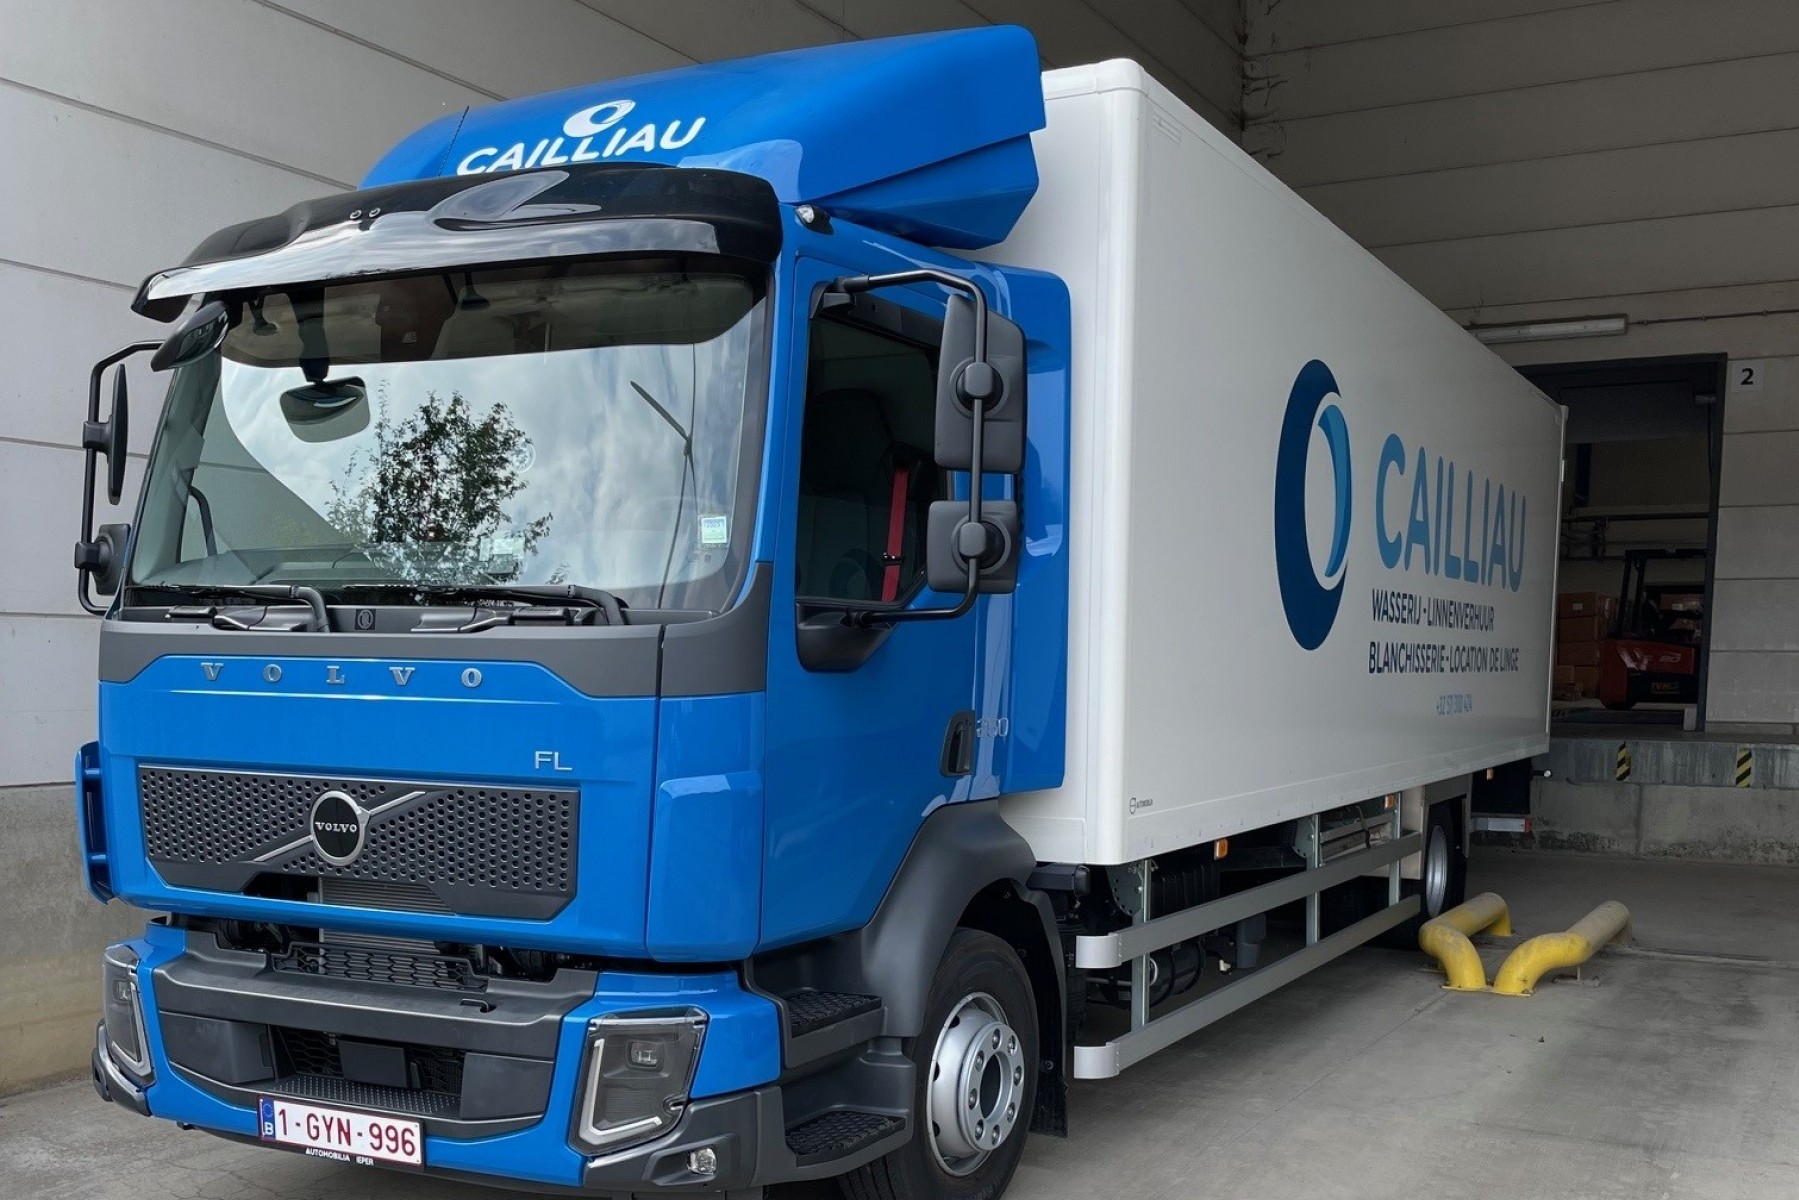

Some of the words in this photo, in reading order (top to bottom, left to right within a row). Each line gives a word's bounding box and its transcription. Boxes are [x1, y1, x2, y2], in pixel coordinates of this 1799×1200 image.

[456, 116, 706, 176] CAILLIAU
[1740, 367, 1754, 386] 2
[1375, 432, 1526, 593] CAILLIAU
[1368, 641, 1446, 674] BLANCHISSERIE
[1449, 645, 1488, 673] LOCATION
[1489, 647, 1500, 672] DE
[200, 662, 483, 689] VOLVO
[534, 750, 574, 772] FL
[314, 821, 358, 835] VOLVO
[264, 1122, 274, 1135] B
[278, 1108, 416, 1157] 1-GYN-996
[305, 1147, 351, 1162] AUTOMOBILIA
[355, 1155, 375, 1166] IEPER
